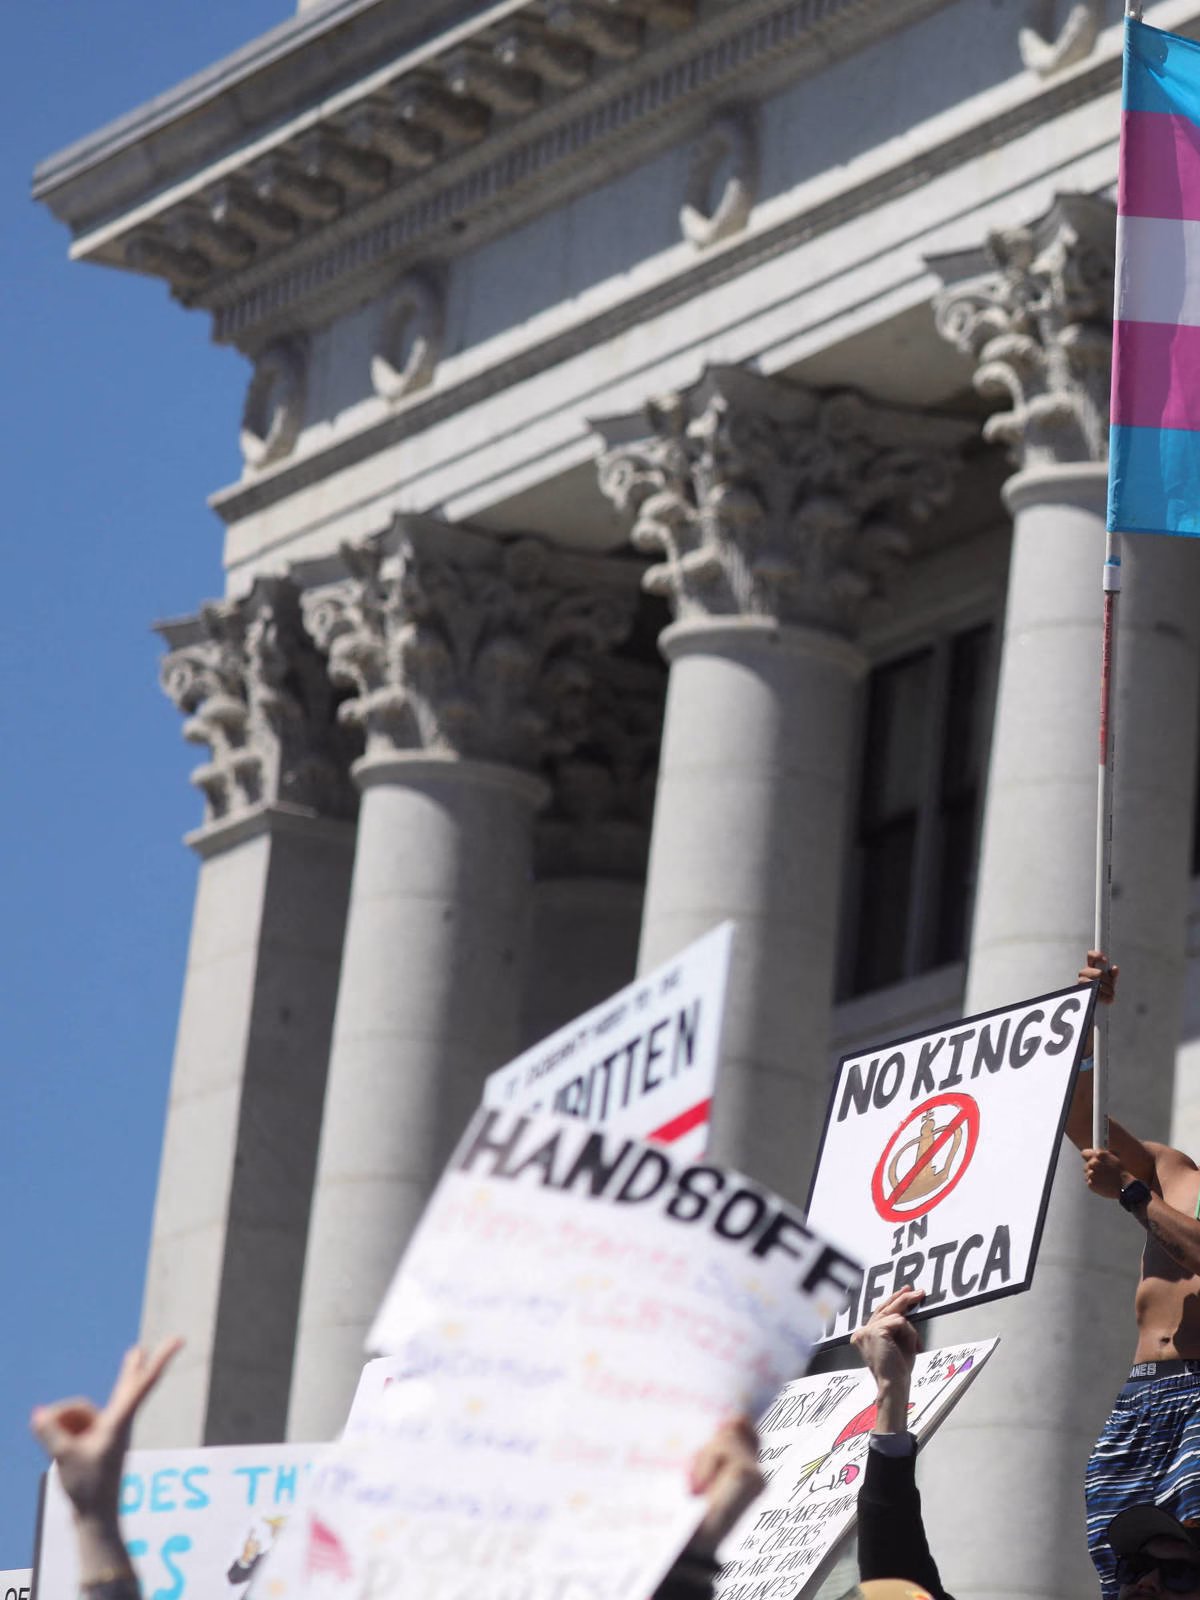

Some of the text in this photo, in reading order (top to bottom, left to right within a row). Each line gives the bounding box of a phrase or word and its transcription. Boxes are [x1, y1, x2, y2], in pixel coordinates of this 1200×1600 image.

[550, 998, 701, 1124] RITTEN
[837, 997, 1081, 1123] NO KINGS
[891, 1214, 928, 1257] IN
[232, 1462, 313, 1506] TH
